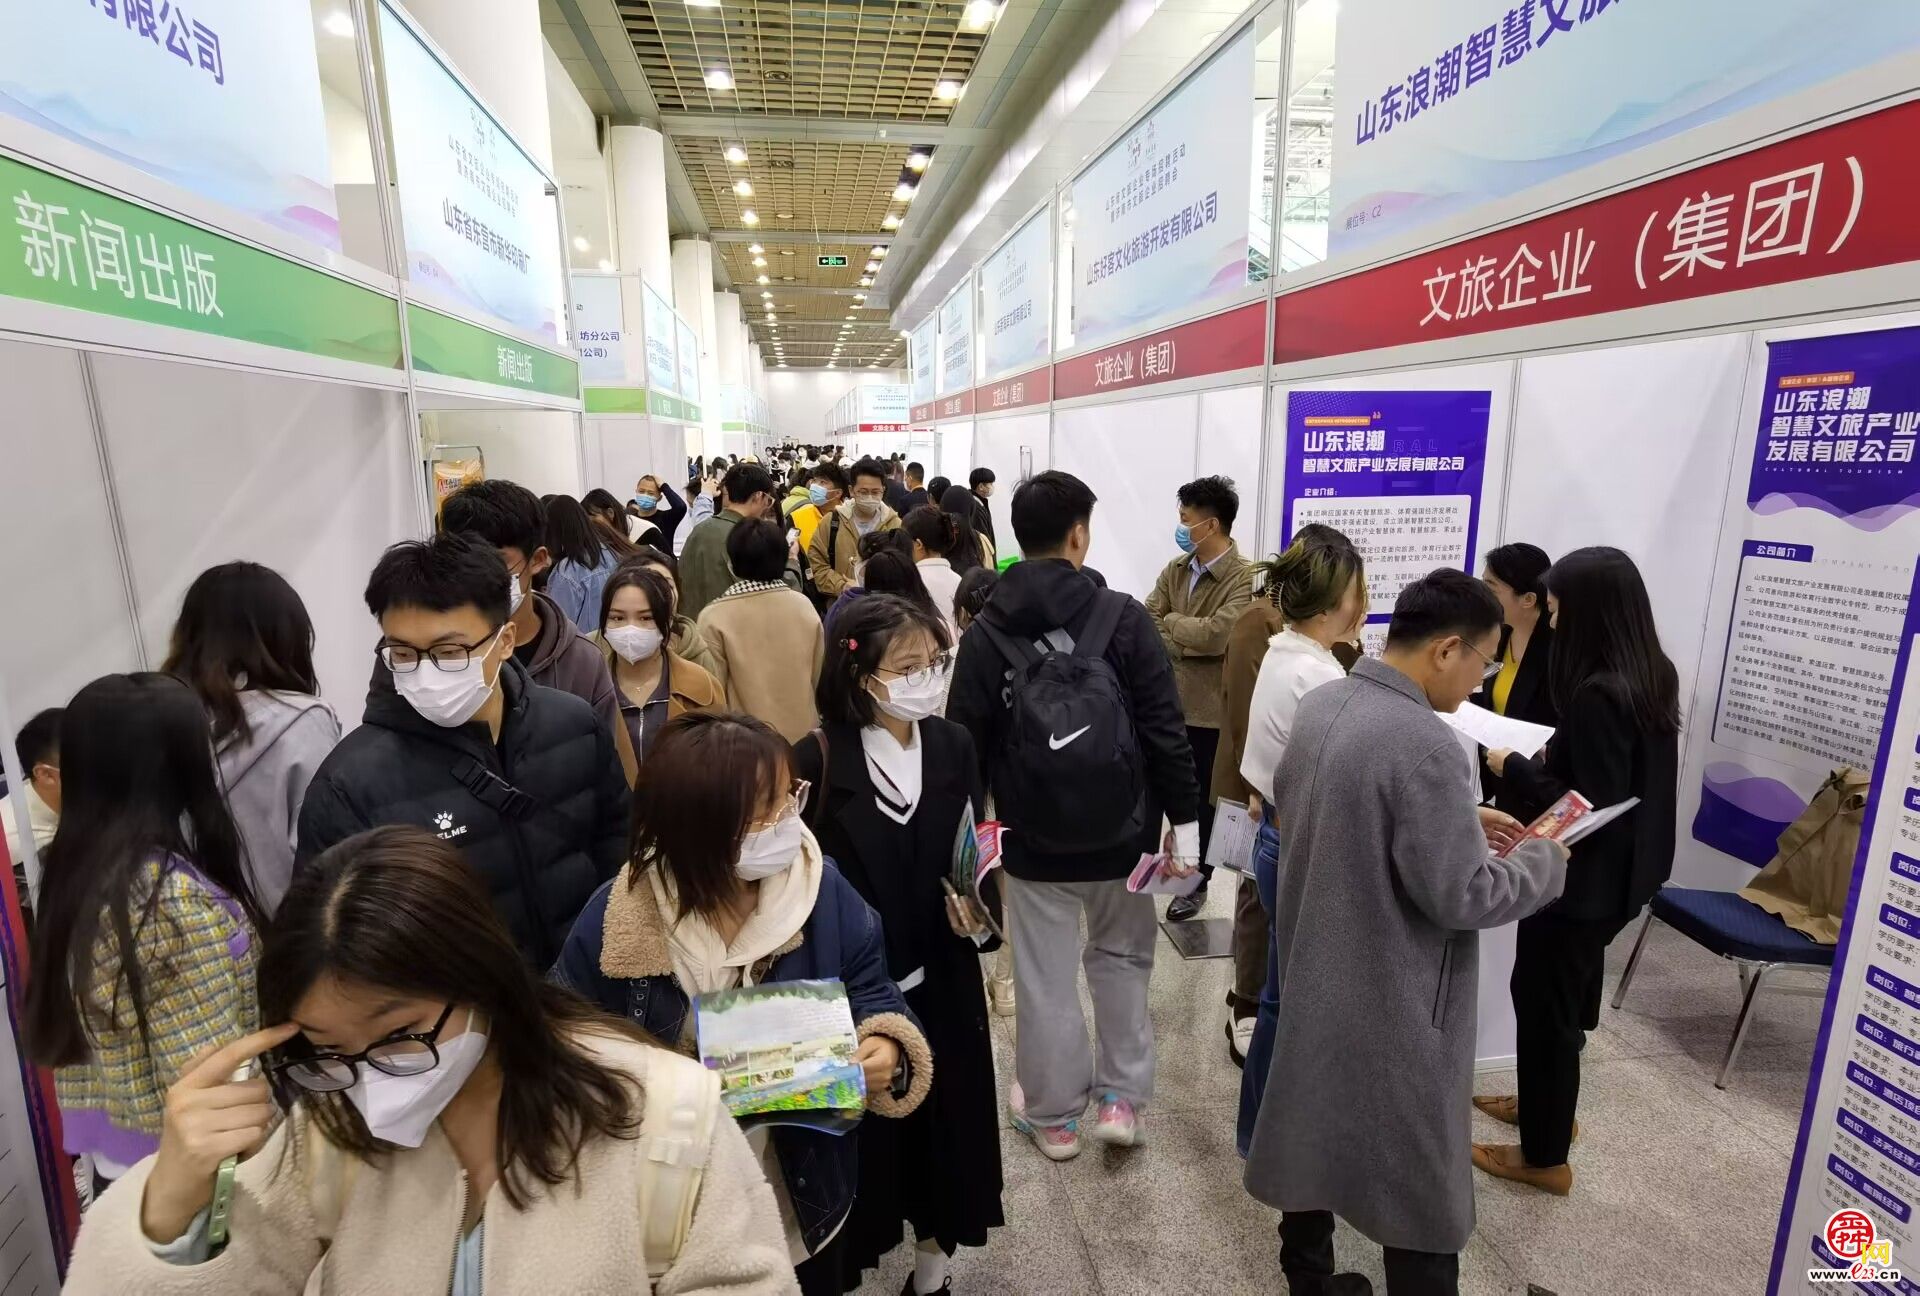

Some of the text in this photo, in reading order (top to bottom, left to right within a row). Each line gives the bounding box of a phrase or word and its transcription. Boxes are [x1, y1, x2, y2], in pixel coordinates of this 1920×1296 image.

[443, 197, 531, 275] 山东省东营市新华印刷厂
[1087, 191, 1218, 286] 山东好客文化旅游开发有限公司
[1420, 156, 1863, 327] 文旅企业（集团）
[14, 190, 223, 318] 新闻出版
[497, 345, 533, 383] 新闻出版
[580, 348, 608, 358] 公司)
[1095, 341, 1176, 386] 文旅企业（集团）
[1774, 387, 1871, 413] 山东浪潮
[1771, 411, 1920, 437] 智慧文旅产业
[1303, 430, 1385, 452] 山东浪潮
[1766, 439, 1915, 463] 发展有限公司
[1303, 457, 1464, 473] 智慧文旅产业发展有限公司
[1757, 545, 1796, 558] 公司简介
